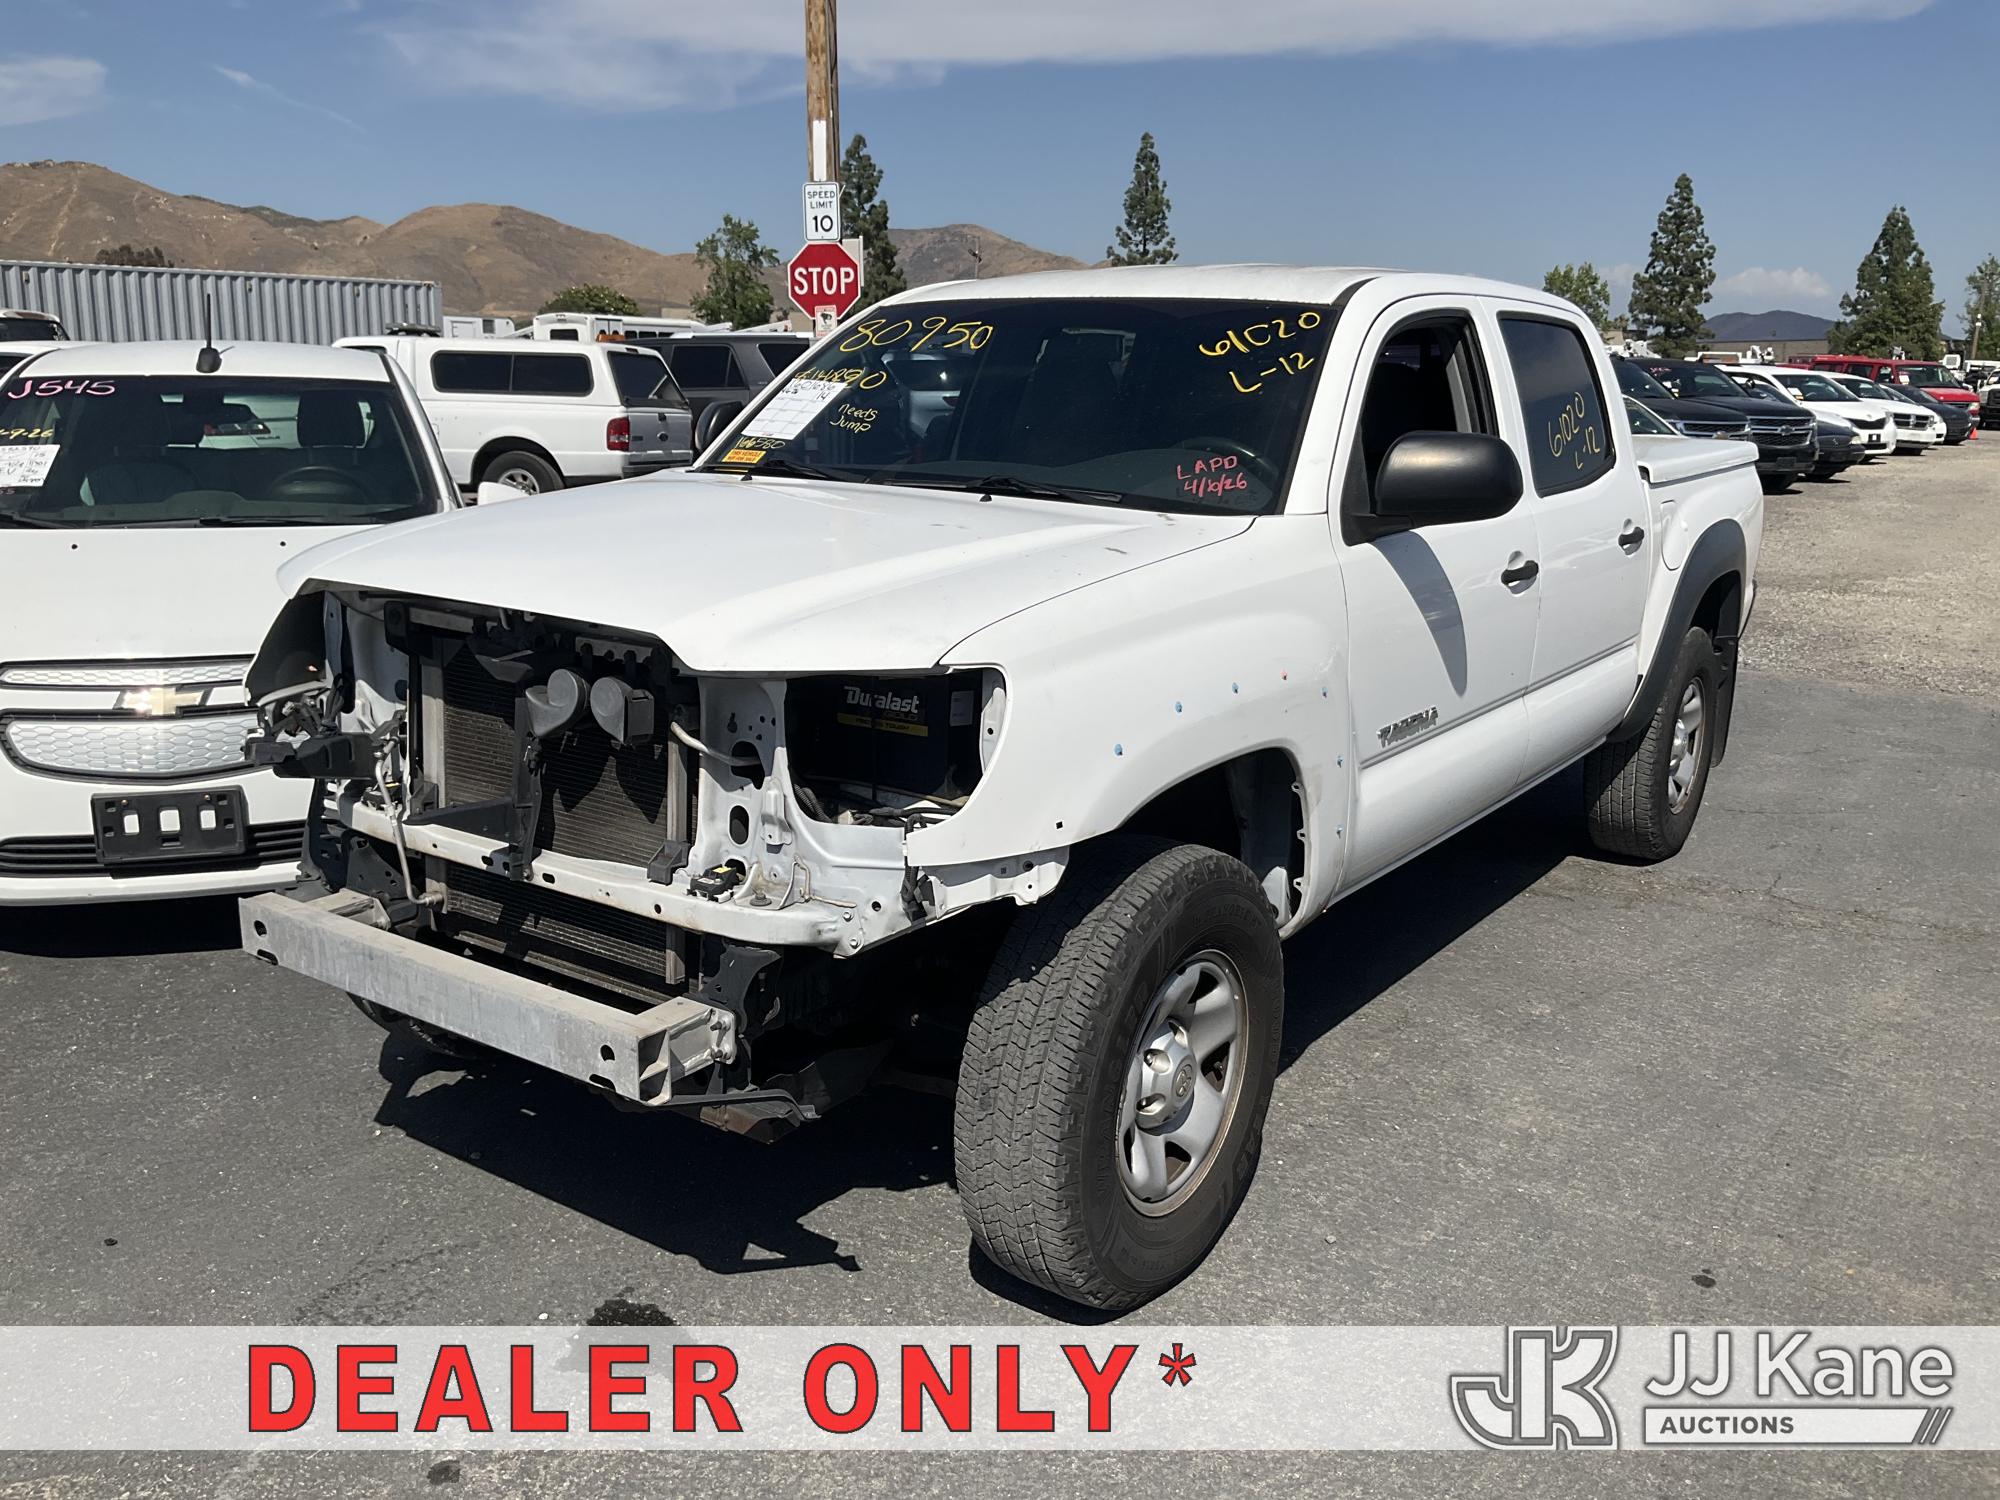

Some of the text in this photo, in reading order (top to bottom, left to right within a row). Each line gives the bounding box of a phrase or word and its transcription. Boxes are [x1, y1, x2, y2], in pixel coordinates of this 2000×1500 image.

[807, 190, 836, 199] SPEED
[810, 200, 834, 209] LIMIT
[812, 214, 834, 233] 10
[793, 266, 855, 296] STOP
[839, 316, 994, 352] 80950
[1228, 352, 1315, 393] L-12
[7, 379, 116, 400] J545
[1547, 391, 1585, 458] 61020
[1574, 425, 1601, 470] L-12
[1176, 455, 1238, 480] LAPD
